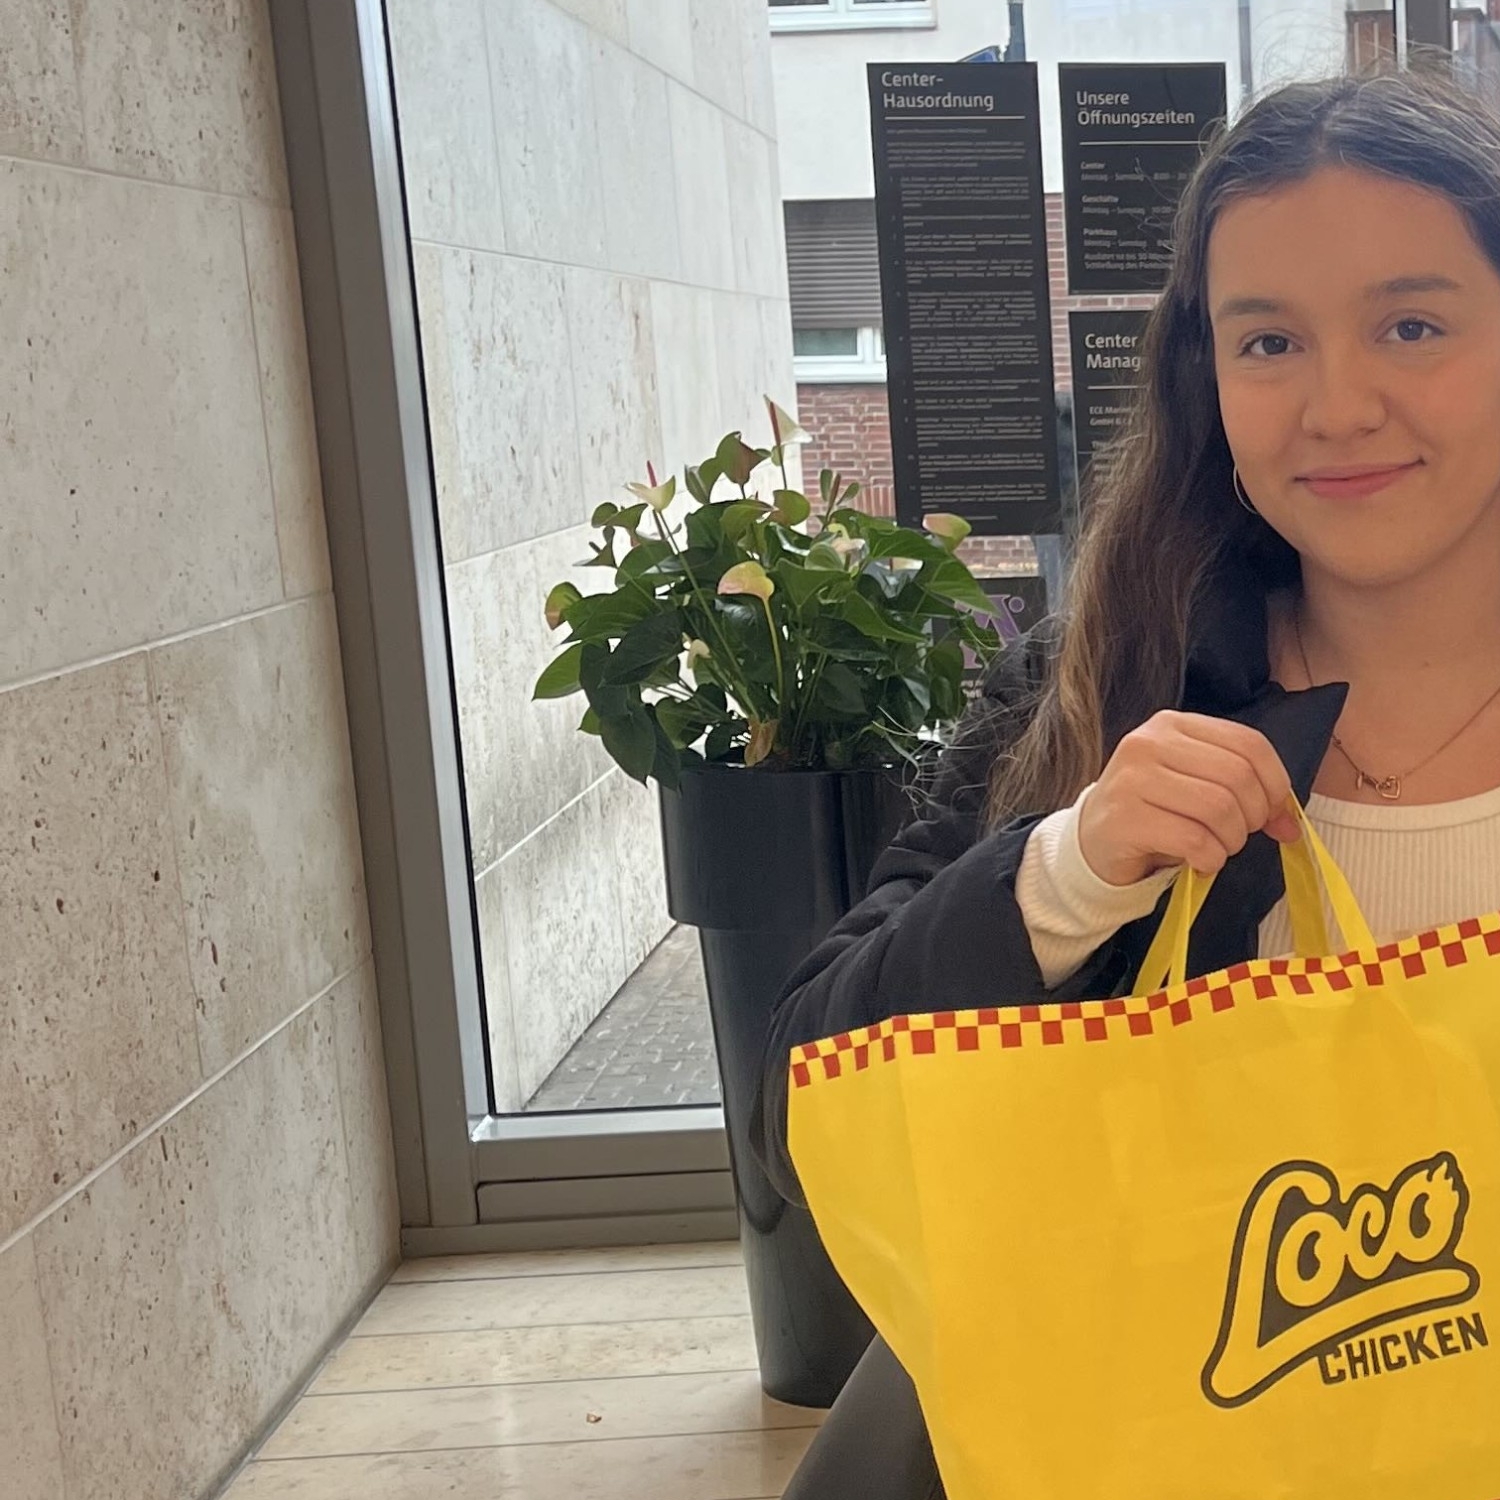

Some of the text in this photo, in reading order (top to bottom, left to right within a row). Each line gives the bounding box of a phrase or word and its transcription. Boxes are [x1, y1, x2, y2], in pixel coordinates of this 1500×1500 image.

[881, 71, 944, 88] Center-
[883, 92, 994, 111] Hausordnung
[1076, 91, 1130, 106] Unsere
[1077, 107, 1195, 128] Öffnungszeiten
[1084, 333, 1139, 349] Center
[1086, 354, 1142, 372] Manag
[1201, 1151, 1480, 1409] Loco
[1317, 1312, 1489, 1385] CHICKEN
